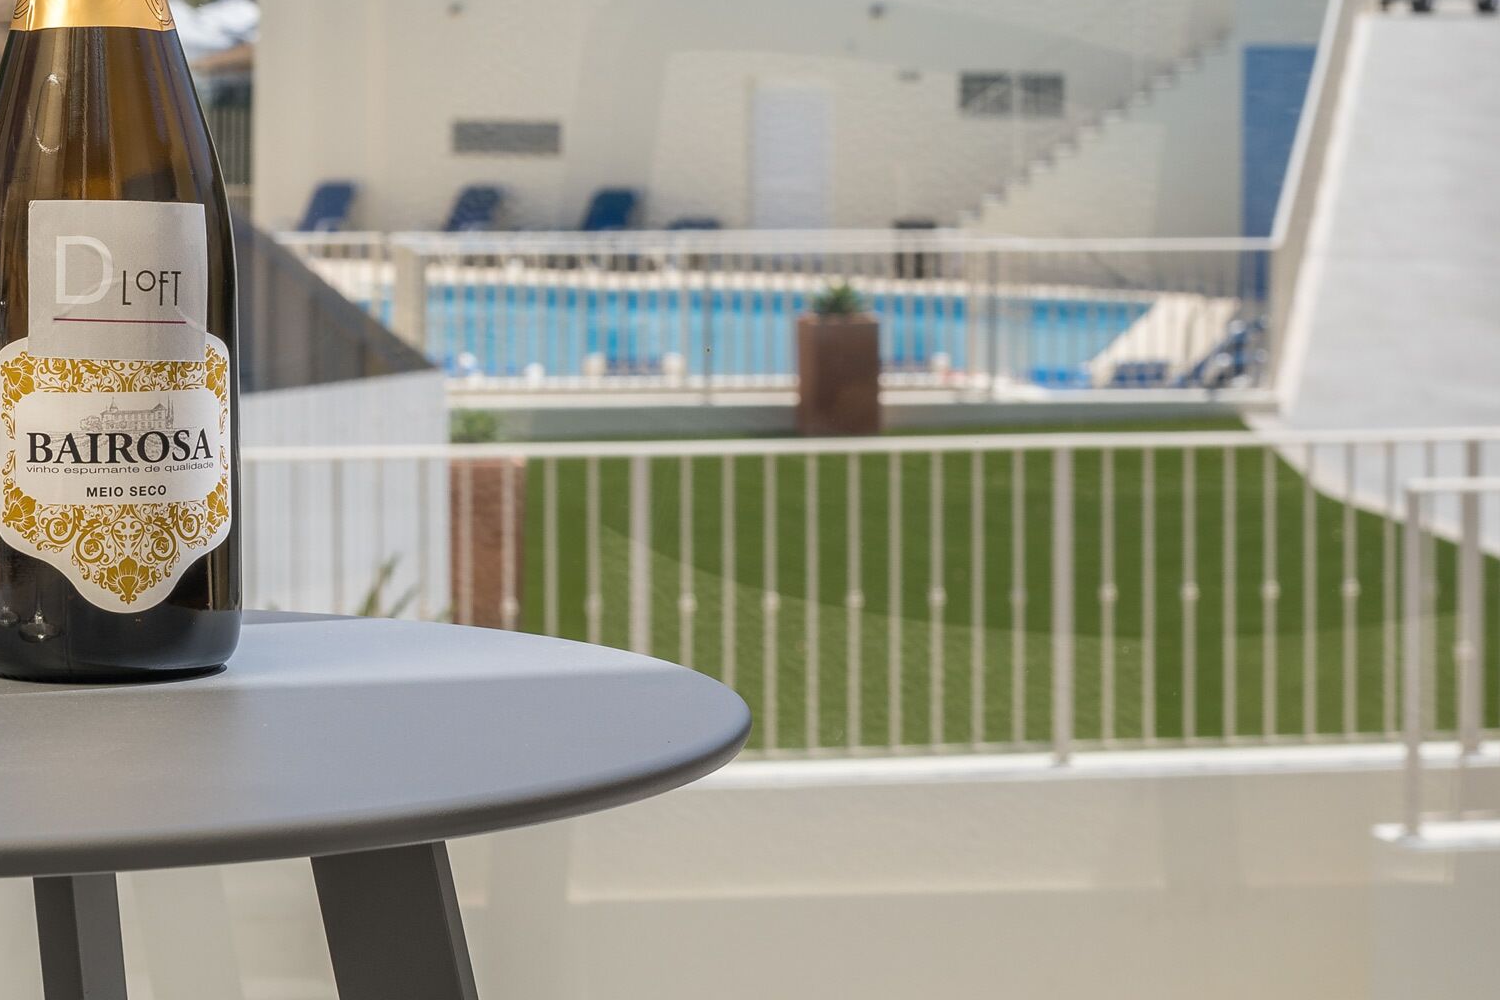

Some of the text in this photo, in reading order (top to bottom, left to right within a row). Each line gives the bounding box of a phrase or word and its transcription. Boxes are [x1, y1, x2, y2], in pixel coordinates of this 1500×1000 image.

[55, 235, 182, 306] D LOFT
[26, 427, 214, 465] BAIROSA
[26, 461, 214, 476] vinho espumante de qualidade
[86, 484, 167, 498] MEIO SECO
